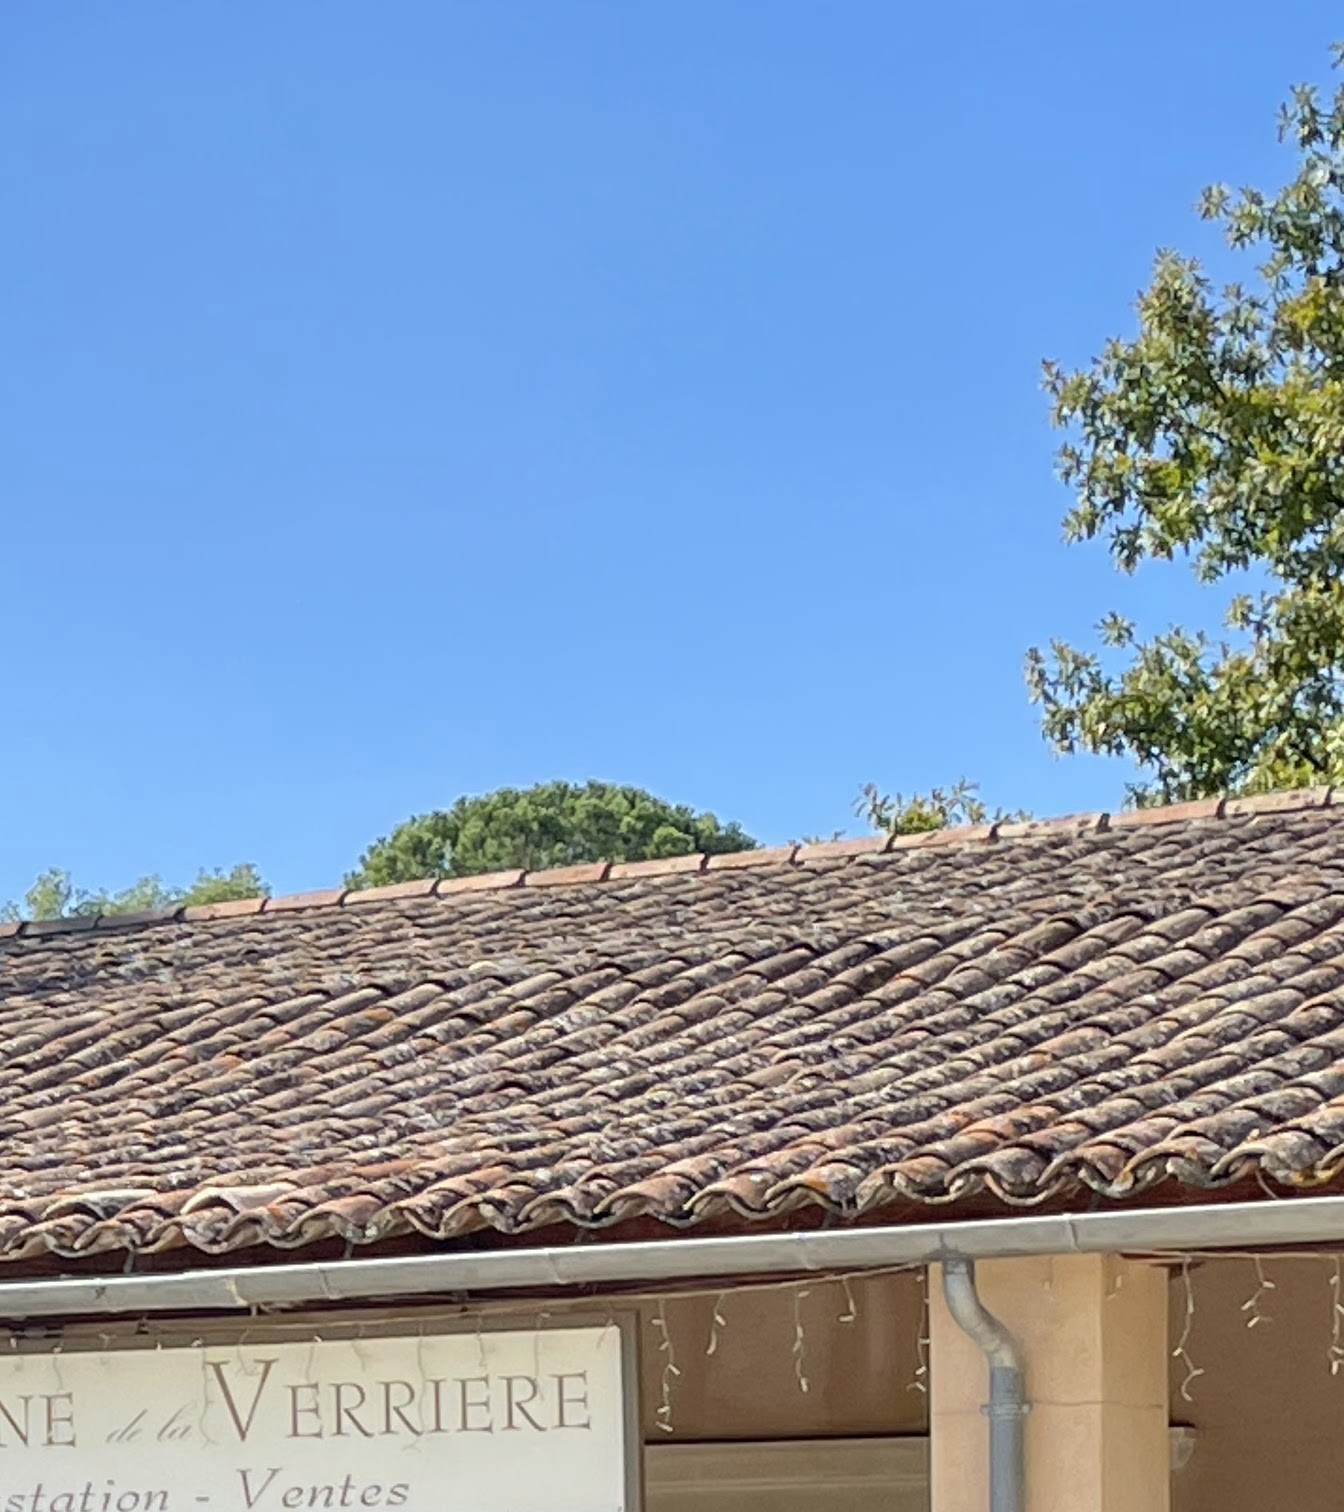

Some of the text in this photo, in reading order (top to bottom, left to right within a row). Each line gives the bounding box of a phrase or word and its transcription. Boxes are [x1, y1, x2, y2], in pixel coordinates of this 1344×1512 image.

[105, 1408, 148, 1444] de
[156, 1404, 195, 1443] la
[207, 1358, 592, 1443] VERRIERE
[236, 1467, 410, 1511] Ventes
